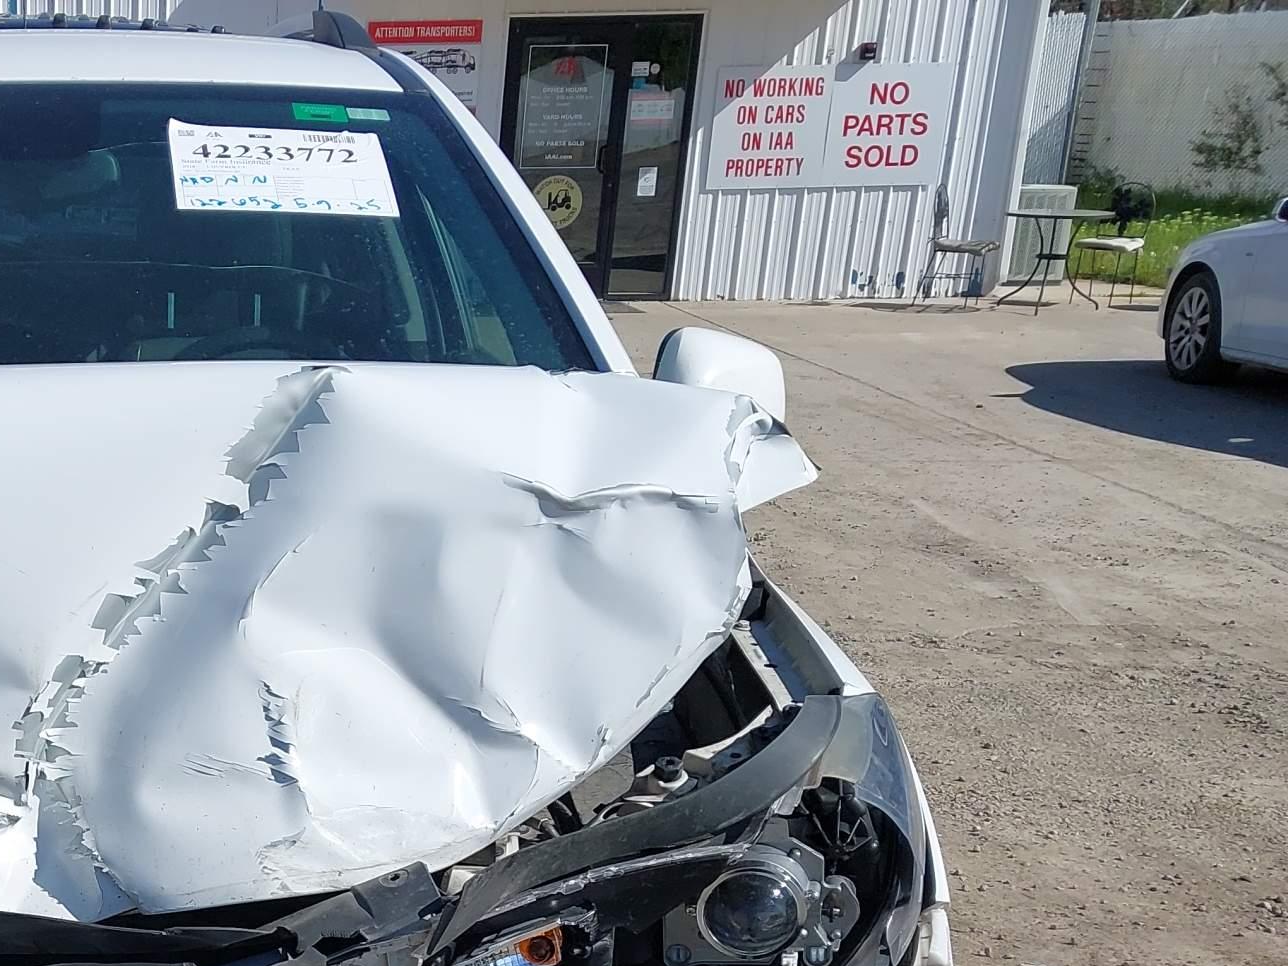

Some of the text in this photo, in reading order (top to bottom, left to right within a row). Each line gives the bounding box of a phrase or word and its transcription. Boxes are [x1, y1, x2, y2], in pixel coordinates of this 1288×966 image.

[374, 25, 476, 38] ATTENTION TRANSPORTERS!
[724, 76, 825, 98] NO WORKING
[869, 81, 910, 105] NO
[737, 104, 806, 125] ON CARS
[842, 112, 929, 137] PARTS
[741, 131, 794, 151] ON IAA
[192, 143, 358, 163] 42233772
[844, 144, 919, 168] SOLD
[725, 157, 804, 178] PROPERTY
